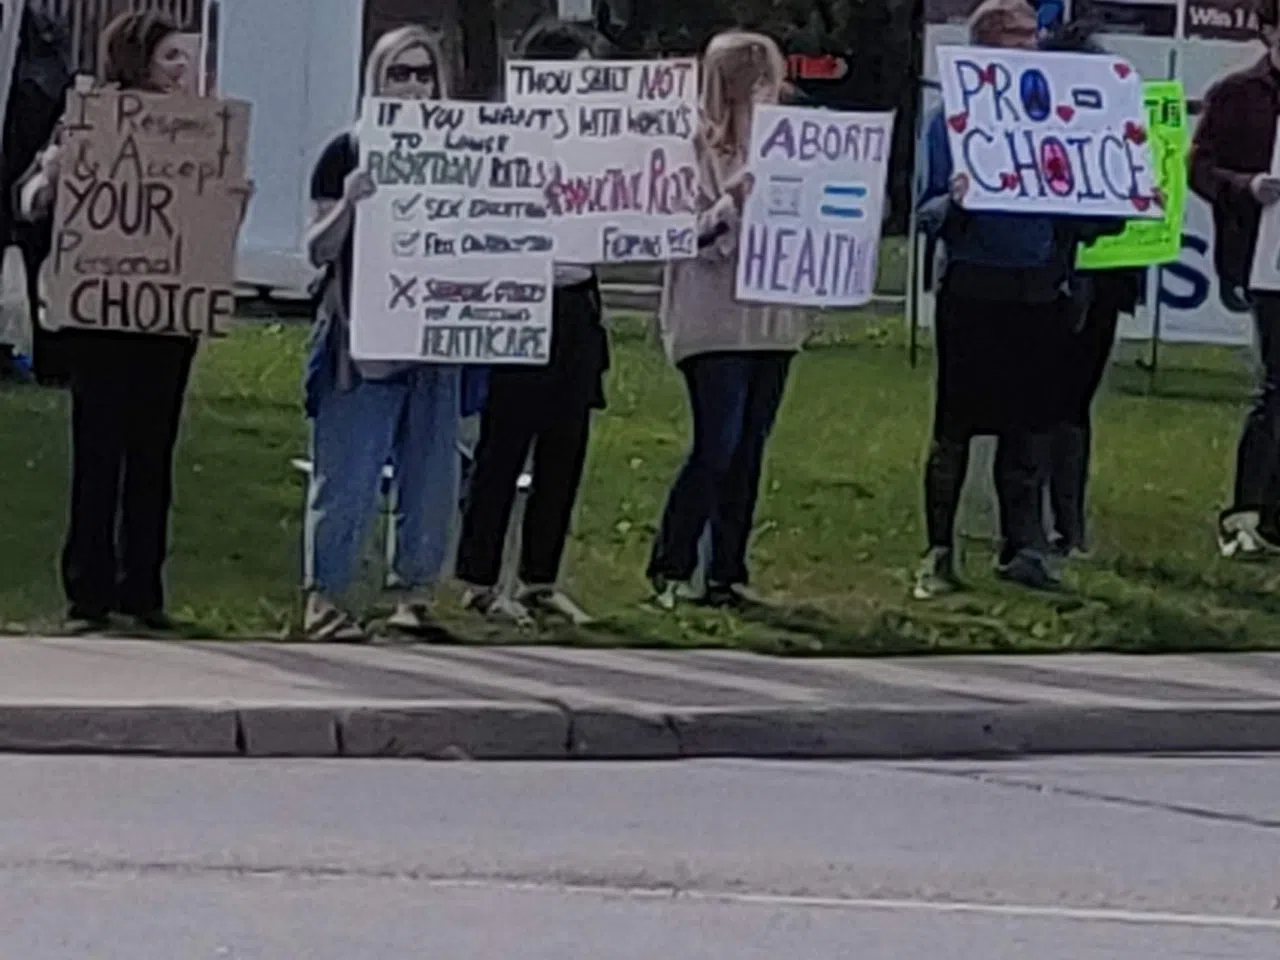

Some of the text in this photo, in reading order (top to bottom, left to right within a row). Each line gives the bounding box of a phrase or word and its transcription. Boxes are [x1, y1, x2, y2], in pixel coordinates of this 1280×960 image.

[510, 65, 572, 95] THOU
[637, 63, 692, 101] NOT
[391, 131, 422, 149] TO
[420, 103, 464, 130] YOU
[962, 128, 1157, 203] CHOICE
[64, 180, 174, 237] YOUR
[70, 278, 233, 338] CHOICE
